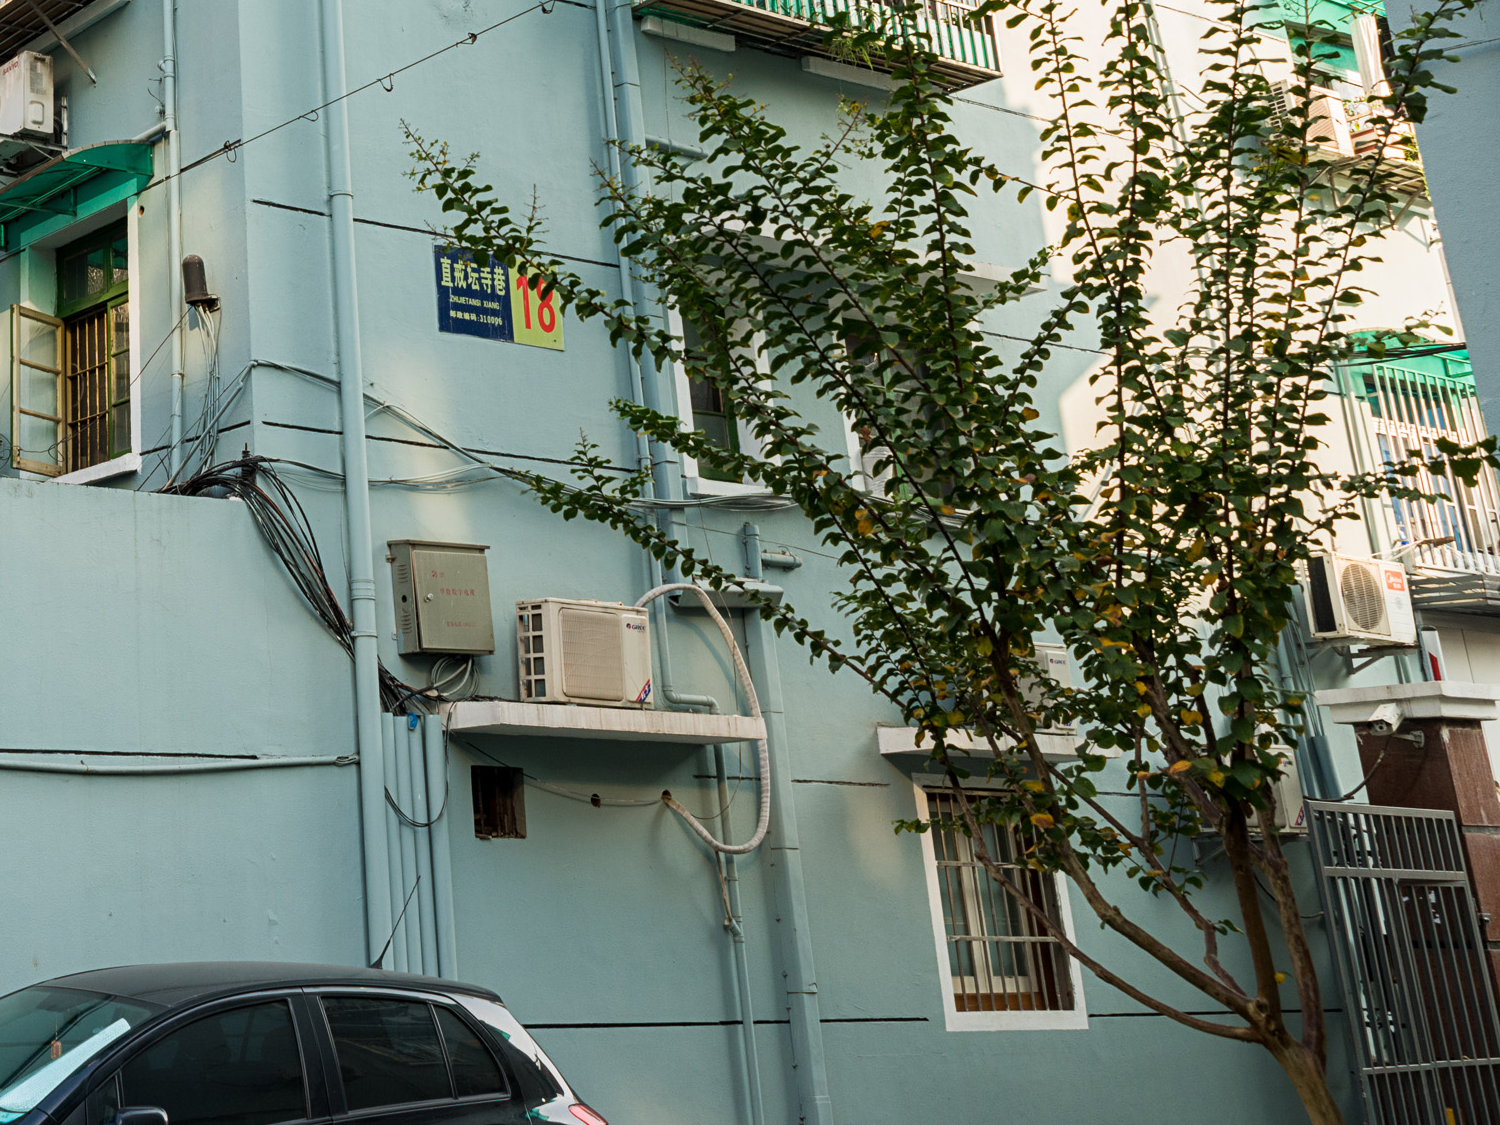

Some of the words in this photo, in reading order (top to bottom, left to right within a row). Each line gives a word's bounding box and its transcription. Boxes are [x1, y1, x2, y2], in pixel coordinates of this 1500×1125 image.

[440, 256, 506, 296] 直戒坛寺巷
[483, 301, 500, 310] XIANG
[516, 275, 556, 334] 18
